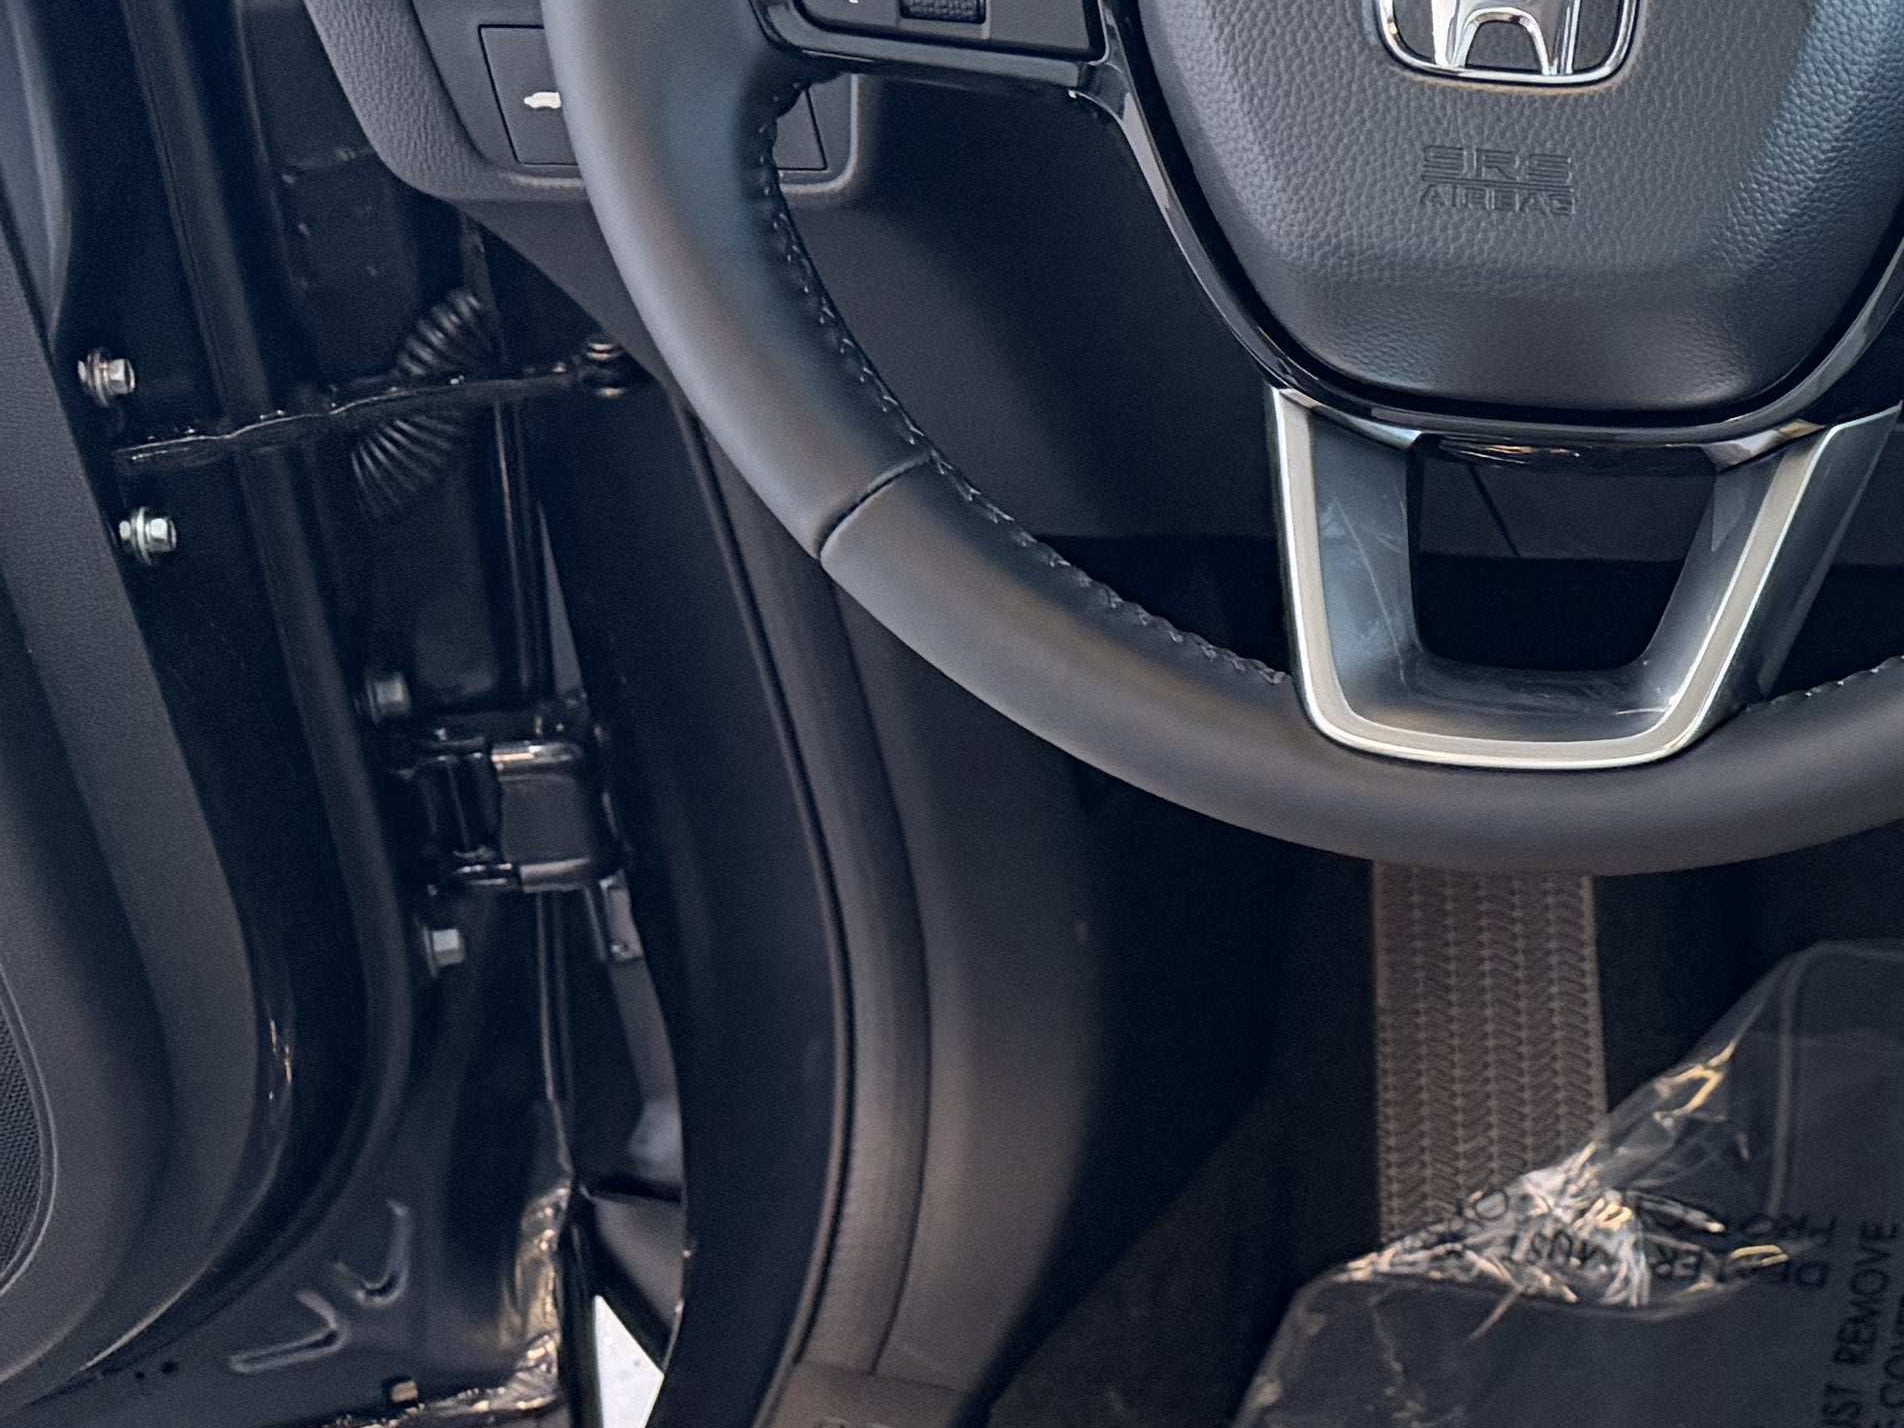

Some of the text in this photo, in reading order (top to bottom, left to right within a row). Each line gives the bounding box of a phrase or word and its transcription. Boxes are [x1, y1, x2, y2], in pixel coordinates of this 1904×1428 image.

[1422, 145, 1574, 183] SRS
[1420, 184, 1577, 217] AIRBAG
[1831, 1219, 1898, 1366] REMOVE
